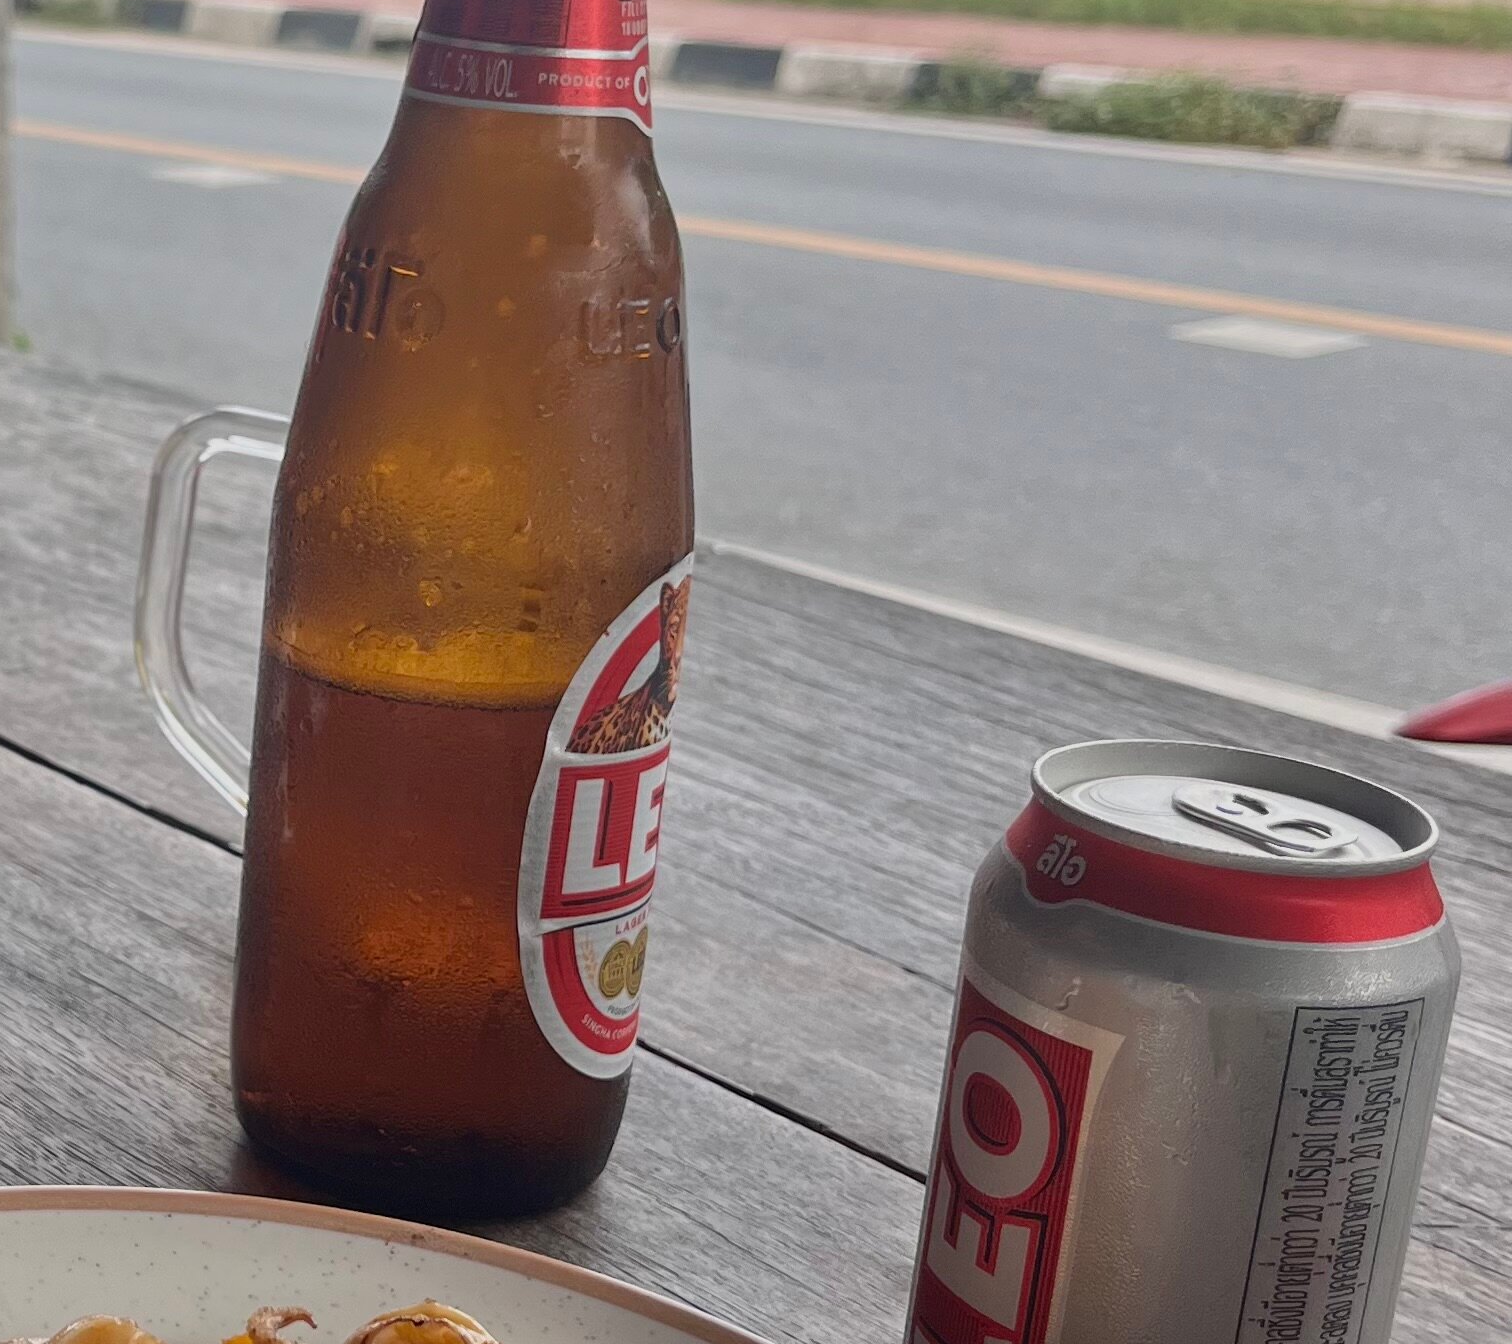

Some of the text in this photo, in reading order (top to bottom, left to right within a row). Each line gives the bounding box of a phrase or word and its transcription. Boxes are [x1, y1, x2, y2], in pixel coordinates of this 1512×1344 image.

[538, 72, 630, 90] PRODUCT OF
[562, 758, 668, 894] LE
[1035, 835, 1086, 887] ลีโอ
[581, 1013, 611, 1039] SINGHA
[1345, 1143, 1383, 1163] 20
[1285, 1204, 1324, 1222] 20
